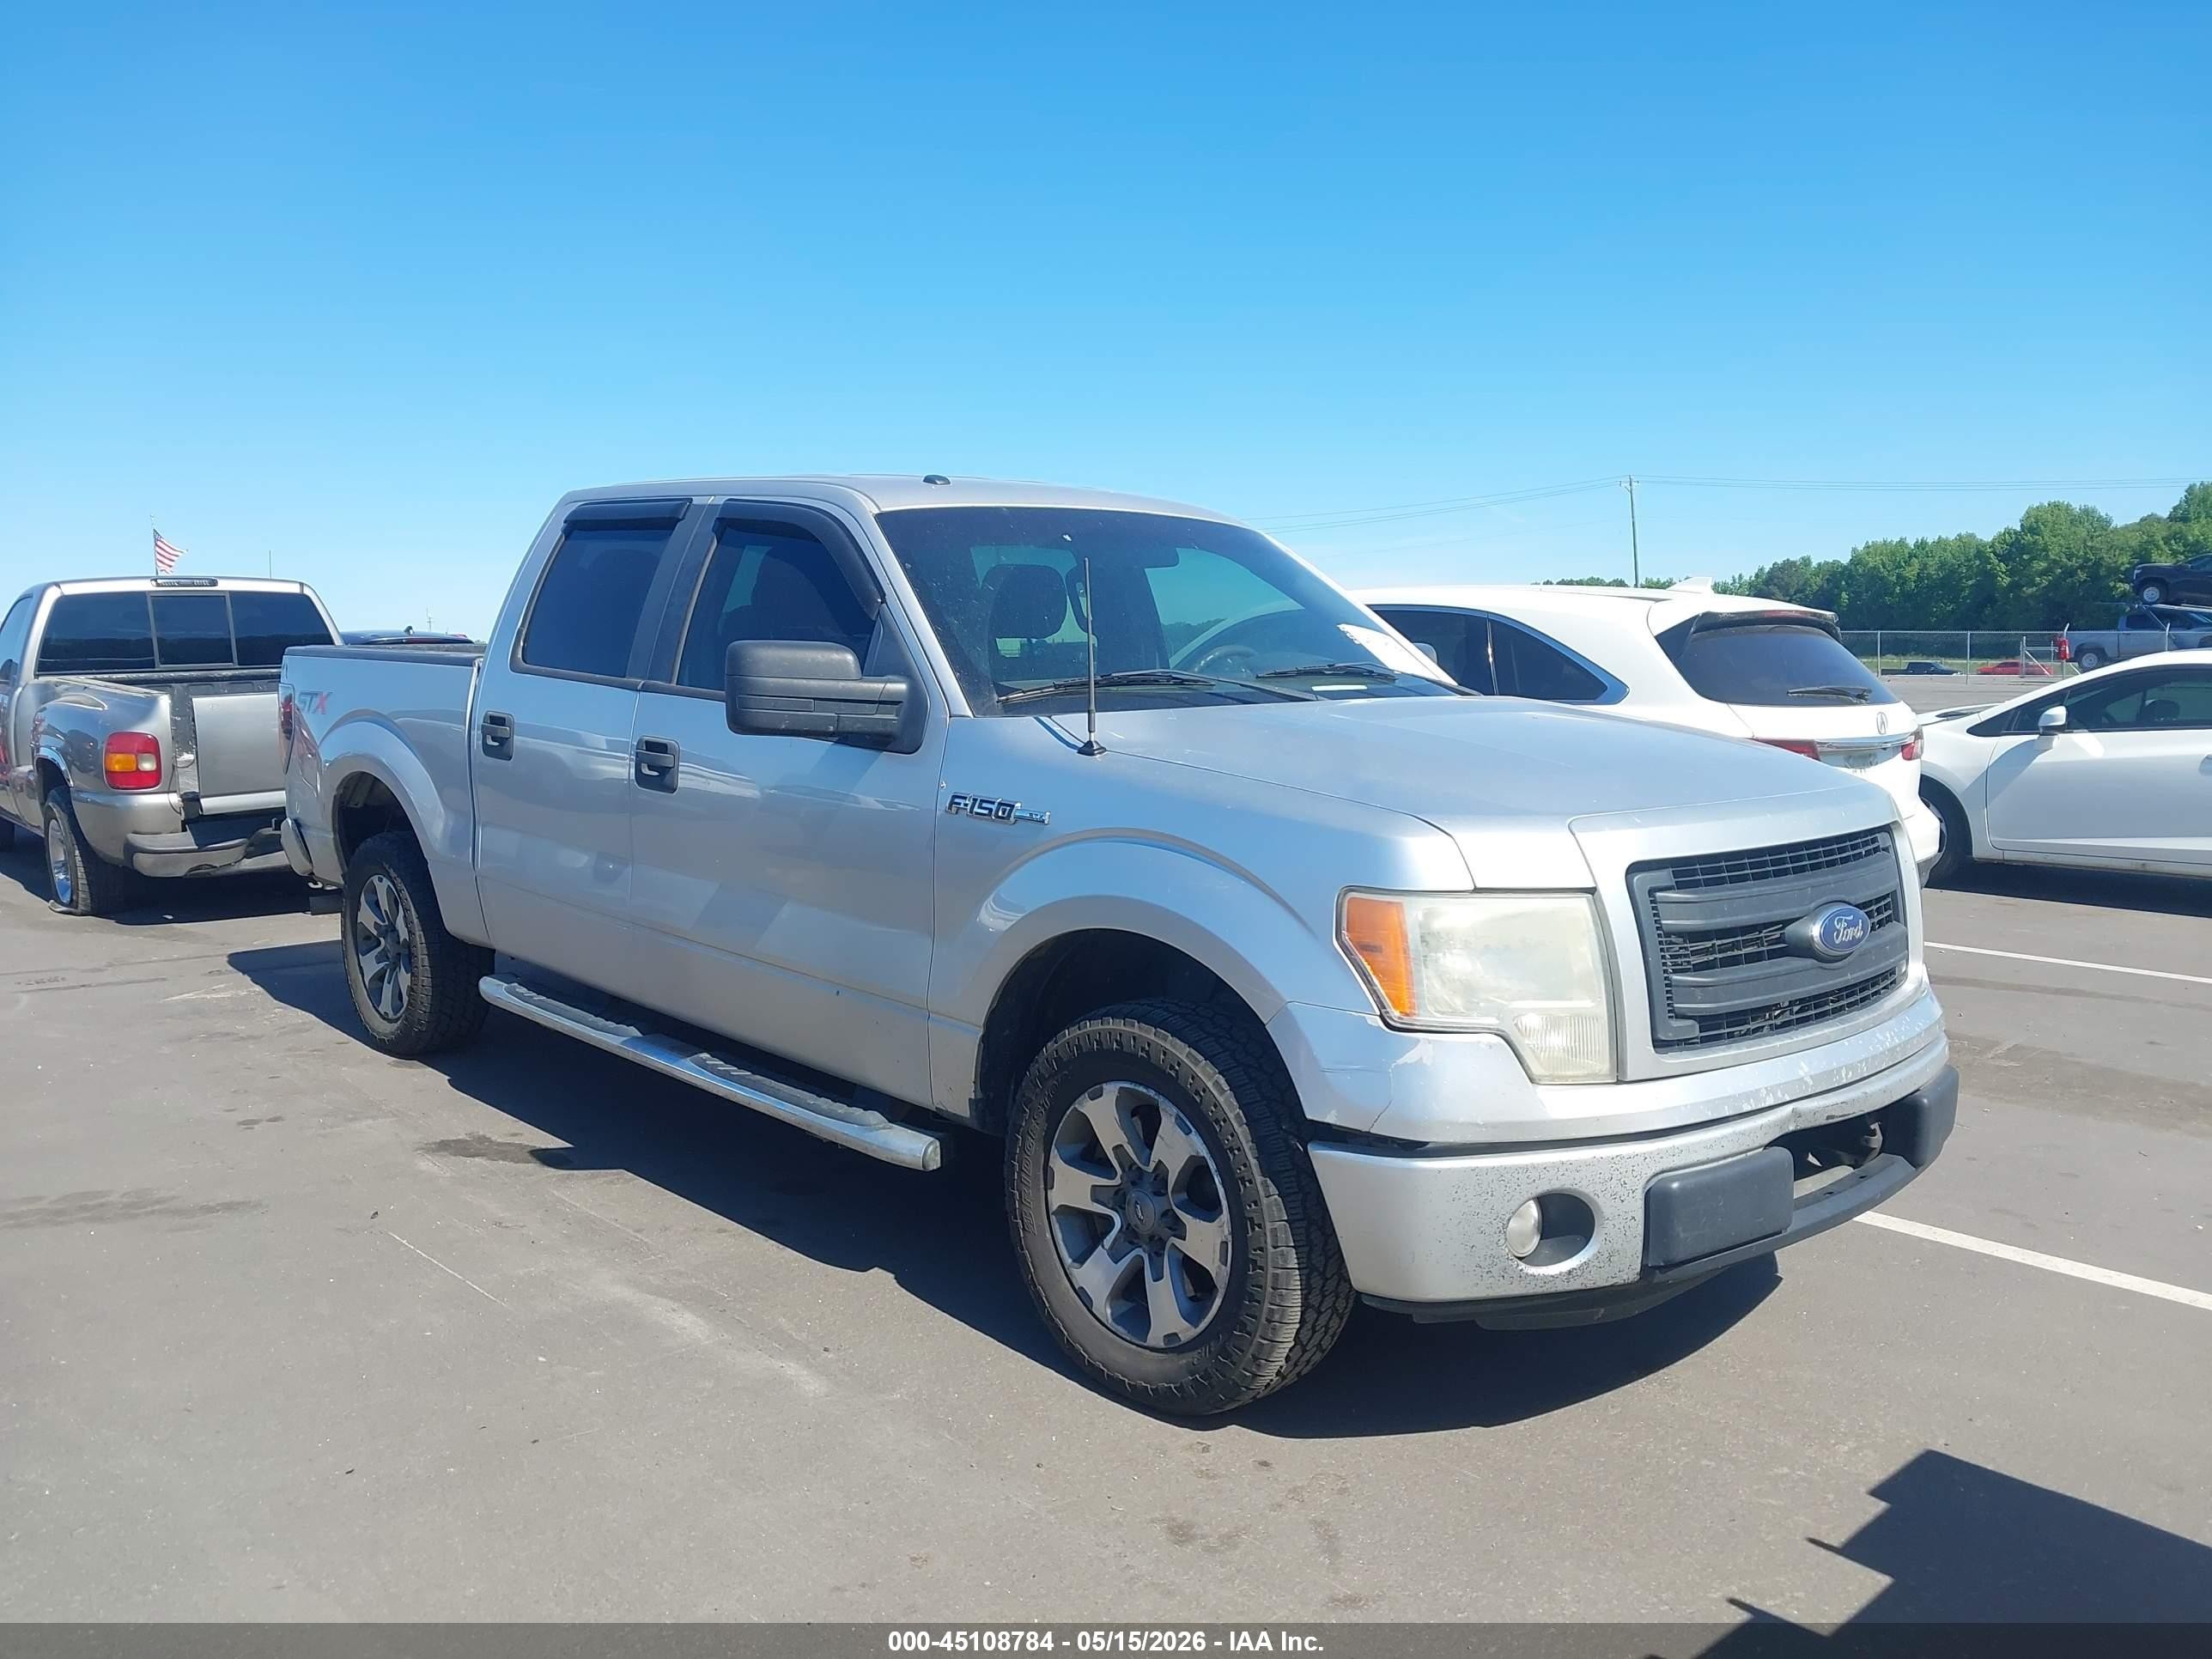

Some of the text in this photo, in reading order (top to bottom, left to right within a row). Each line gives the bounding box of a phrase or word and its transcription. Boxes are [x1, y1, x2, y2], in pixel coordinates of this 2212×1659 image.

[296, 690, 333, 714] STX
[947, 792, 1018, 823] F-150
[1834, 915, 1863, 945] Ford
